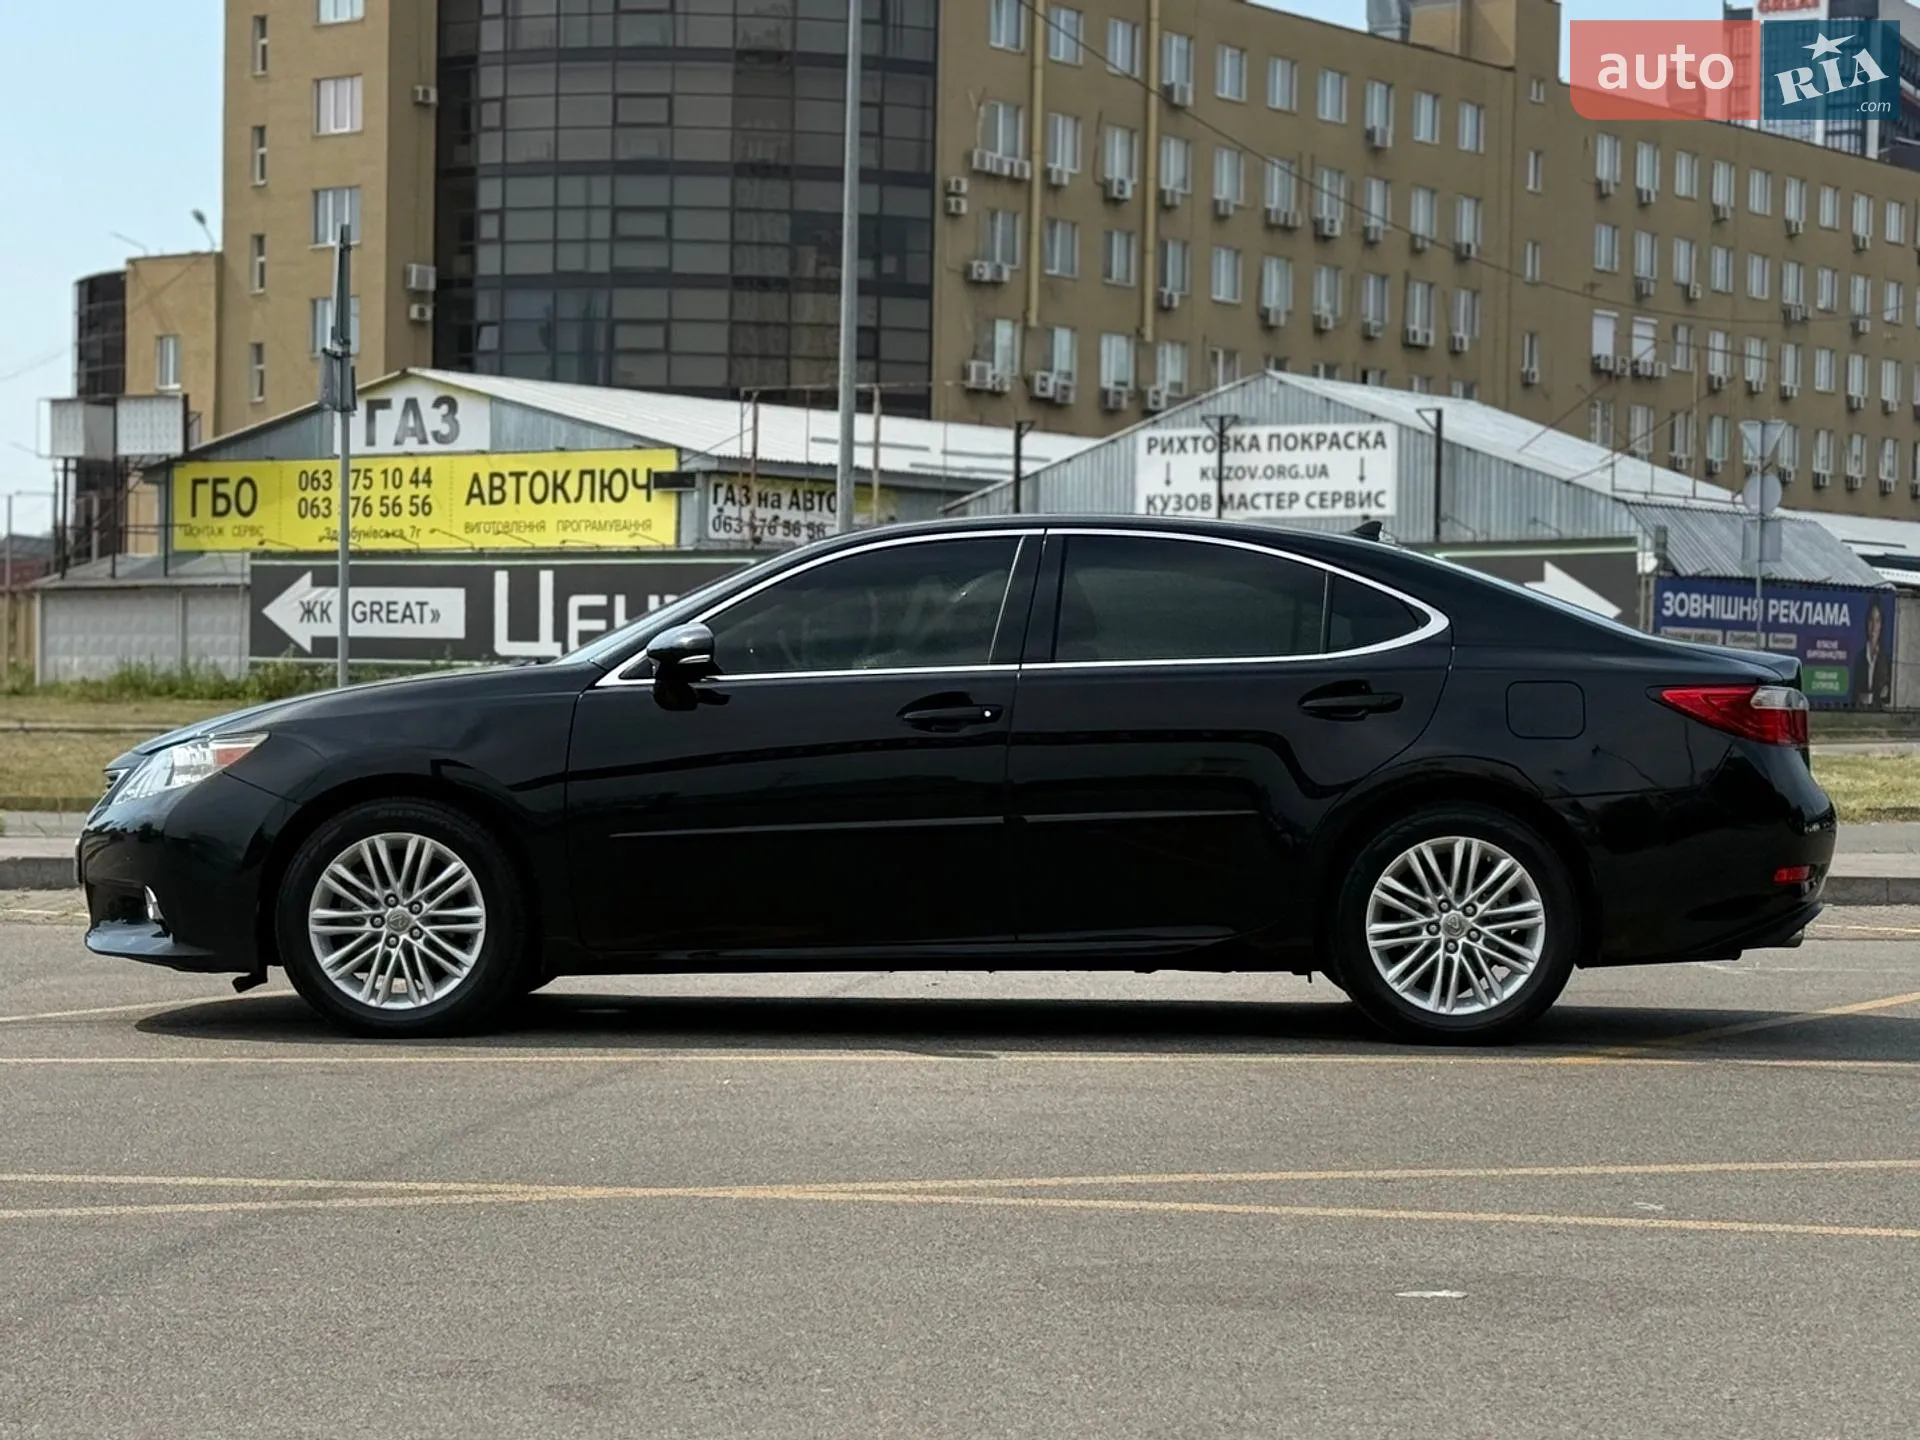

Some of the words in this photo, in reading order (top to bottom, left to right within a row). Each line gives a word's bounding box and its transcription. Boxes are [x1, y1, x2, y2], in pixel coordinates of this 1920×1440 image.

[365, 395, 460, 447] ГАЗ
[1147, 431, 1260, 455] РИХТОВКА
[1267, 430, 1387, 452] ПОКРАСКА
[298, 469, 333, 492] 063
[346, 468, 374, 490] 75
[380, 467, 403, 488] 10
[409, 466, 433, 488] 44
[1200, 463, 1329, 482] KUZOV.ORG.UA
[190, 476, 258, 518] ГБО
[465, 467, 653, 506] АВТОКЛЮЧ
[713, 482, 751, 507] ГАЗ
[757, 491, 782, 510] на
[788, 488, 837, 513] АВТО
[298, 497, 333, 519] 063
[346, 496, 373, 518] 76
[379, 496, 403, 517] 56
[408, 494, 433, 517] 56
[1146, 493, 1212, 514] КУЗОВ
[1221, 491, 1300, 512] МАСТЕР
[1305, 489, 1387, 510] СЕРВИС
[324, 526, 405, 542] Здбунівська
[464, 519, 547, 534] ВИГОТОВЛЕННЯ
[556, 518, 653, 533] ПРОГРАМУВАННЯ
[712, 514, 743, 533] 063
[300, 601, 333, 624] ЖК
[350, 601, 441, 624] GREAT»
[1661, 592, 1764, 622] ЗОВНІШНЯ
[1768, 599, 1851, 627] РЕКЛАМА
